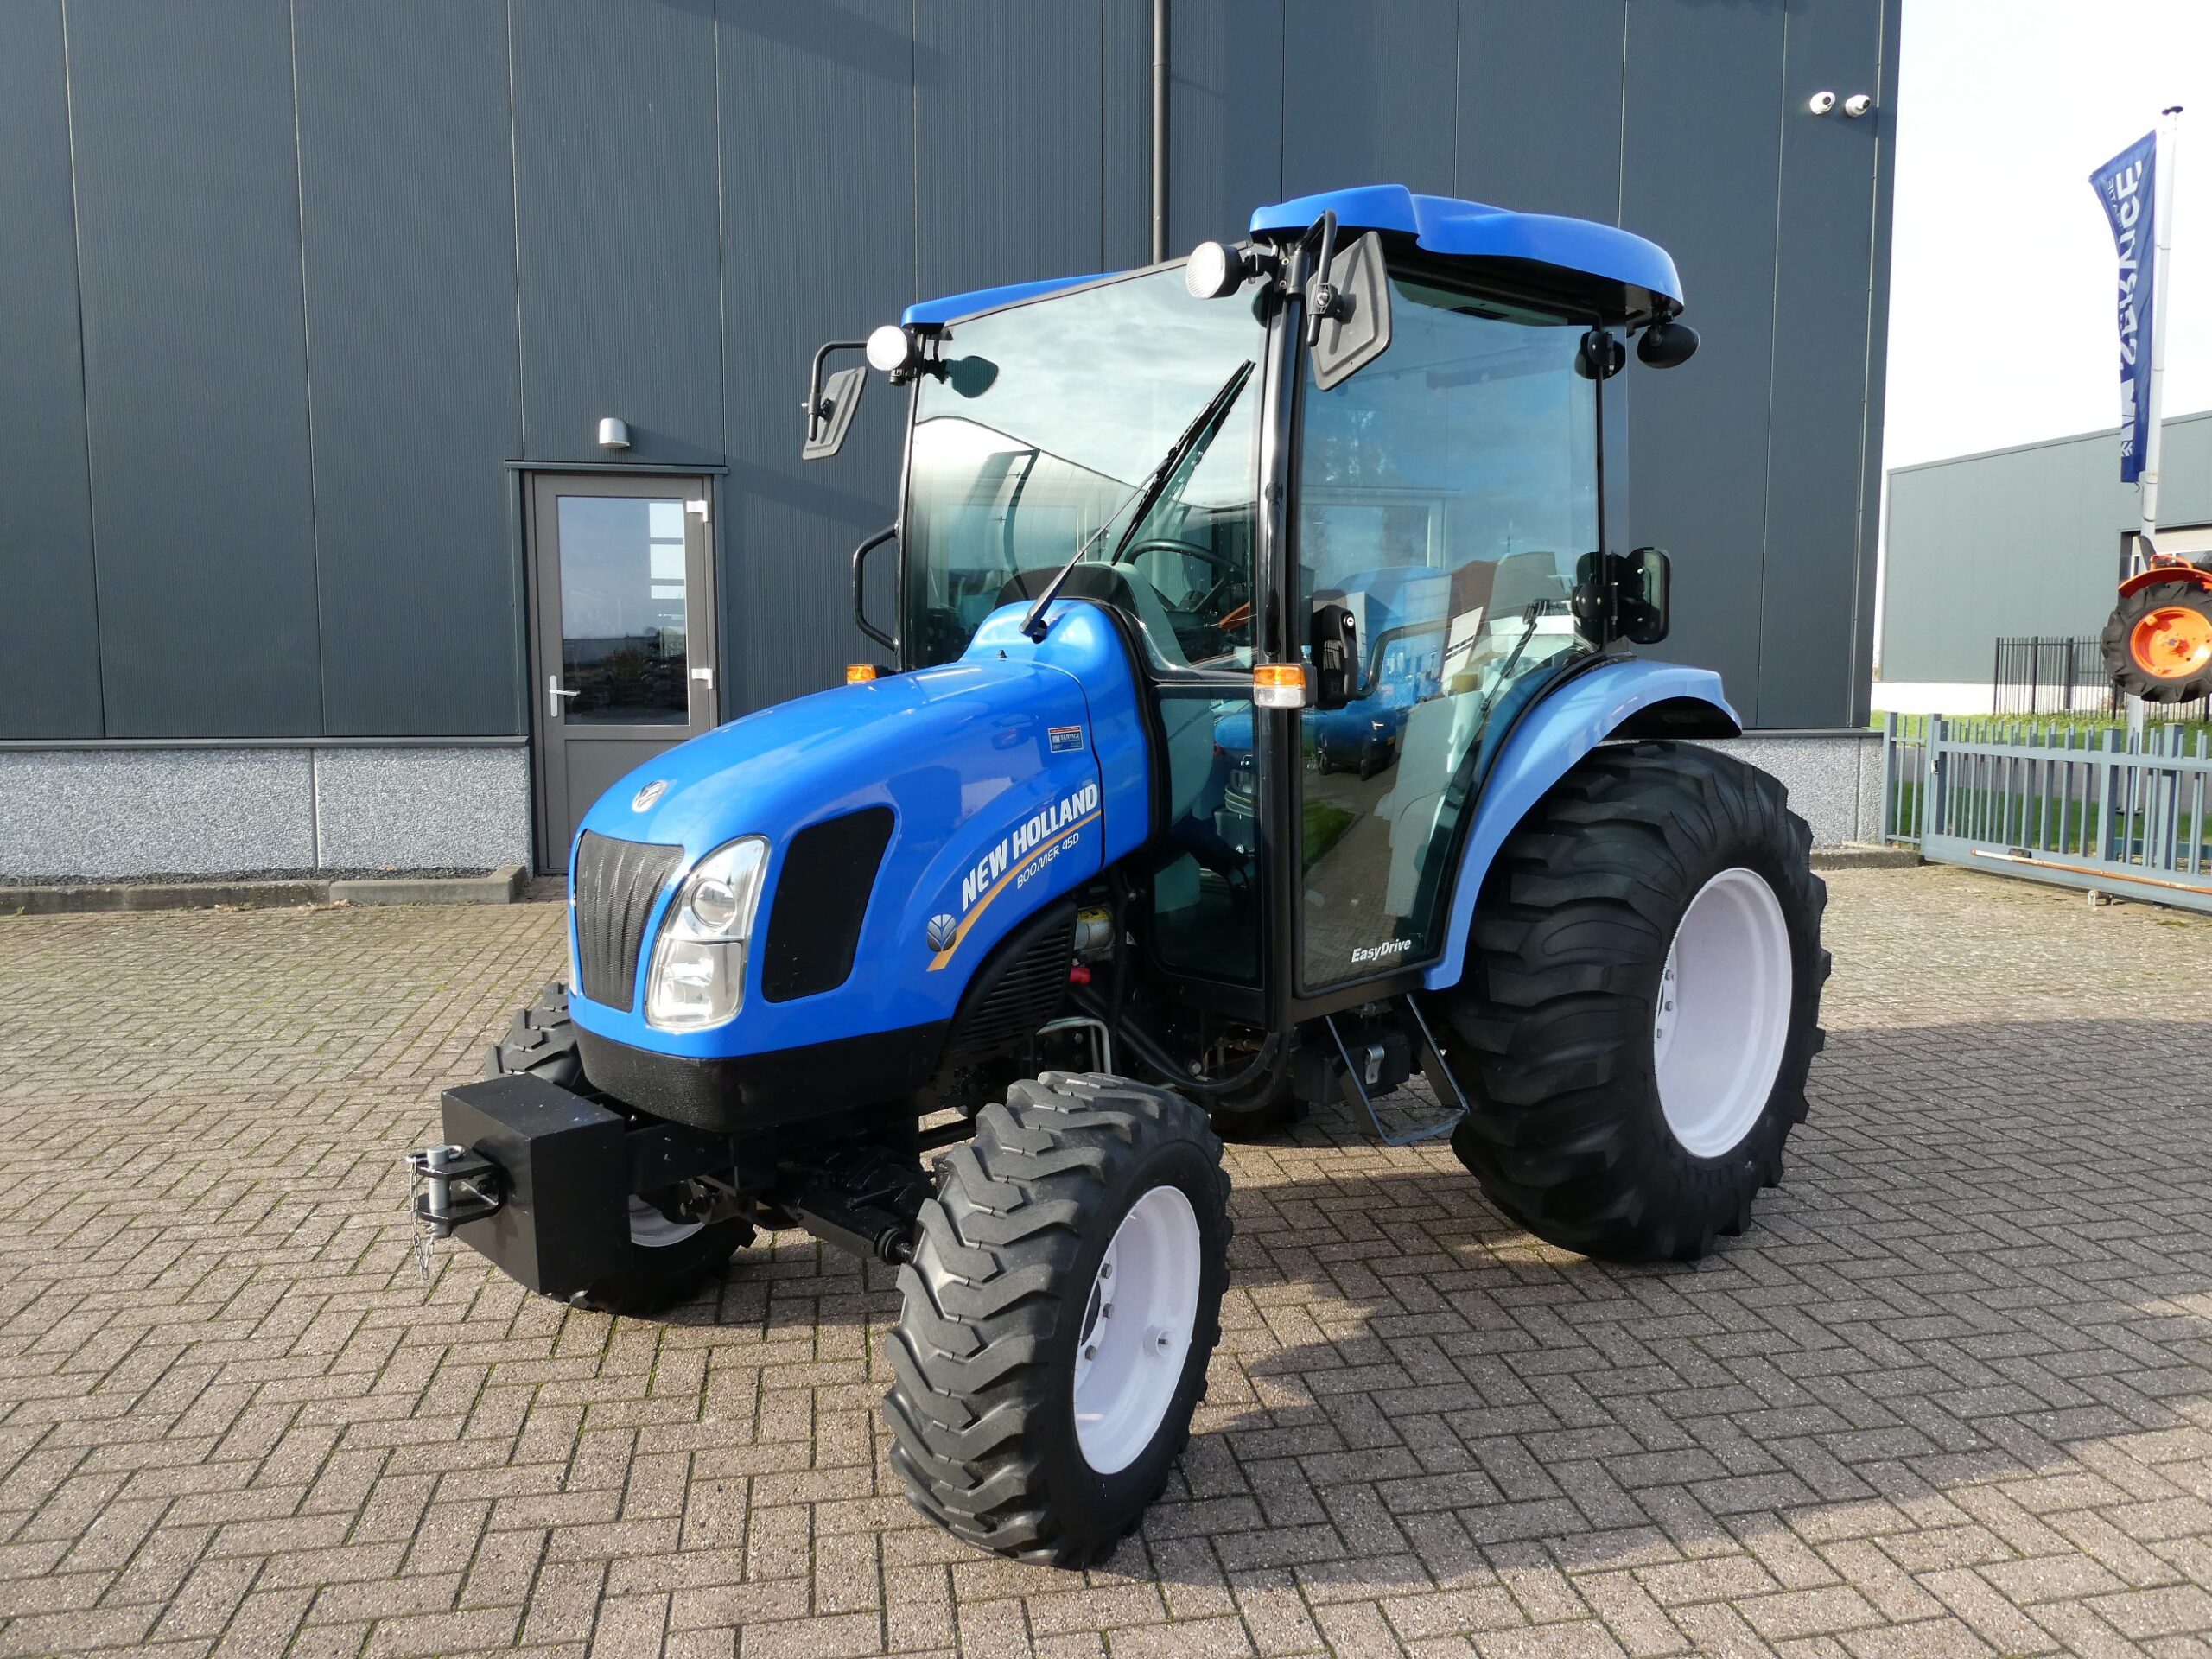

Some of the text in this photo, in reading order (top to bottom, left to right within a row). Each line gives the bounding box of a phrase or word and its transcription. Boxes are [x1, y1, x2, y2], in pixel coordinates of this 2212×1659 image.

[963, 784, 1098, 912] NEW HOLLAND
[1017, 845, 1060, 889] BOOMER
[1351, 938, 1411, 963] EasyDrive
